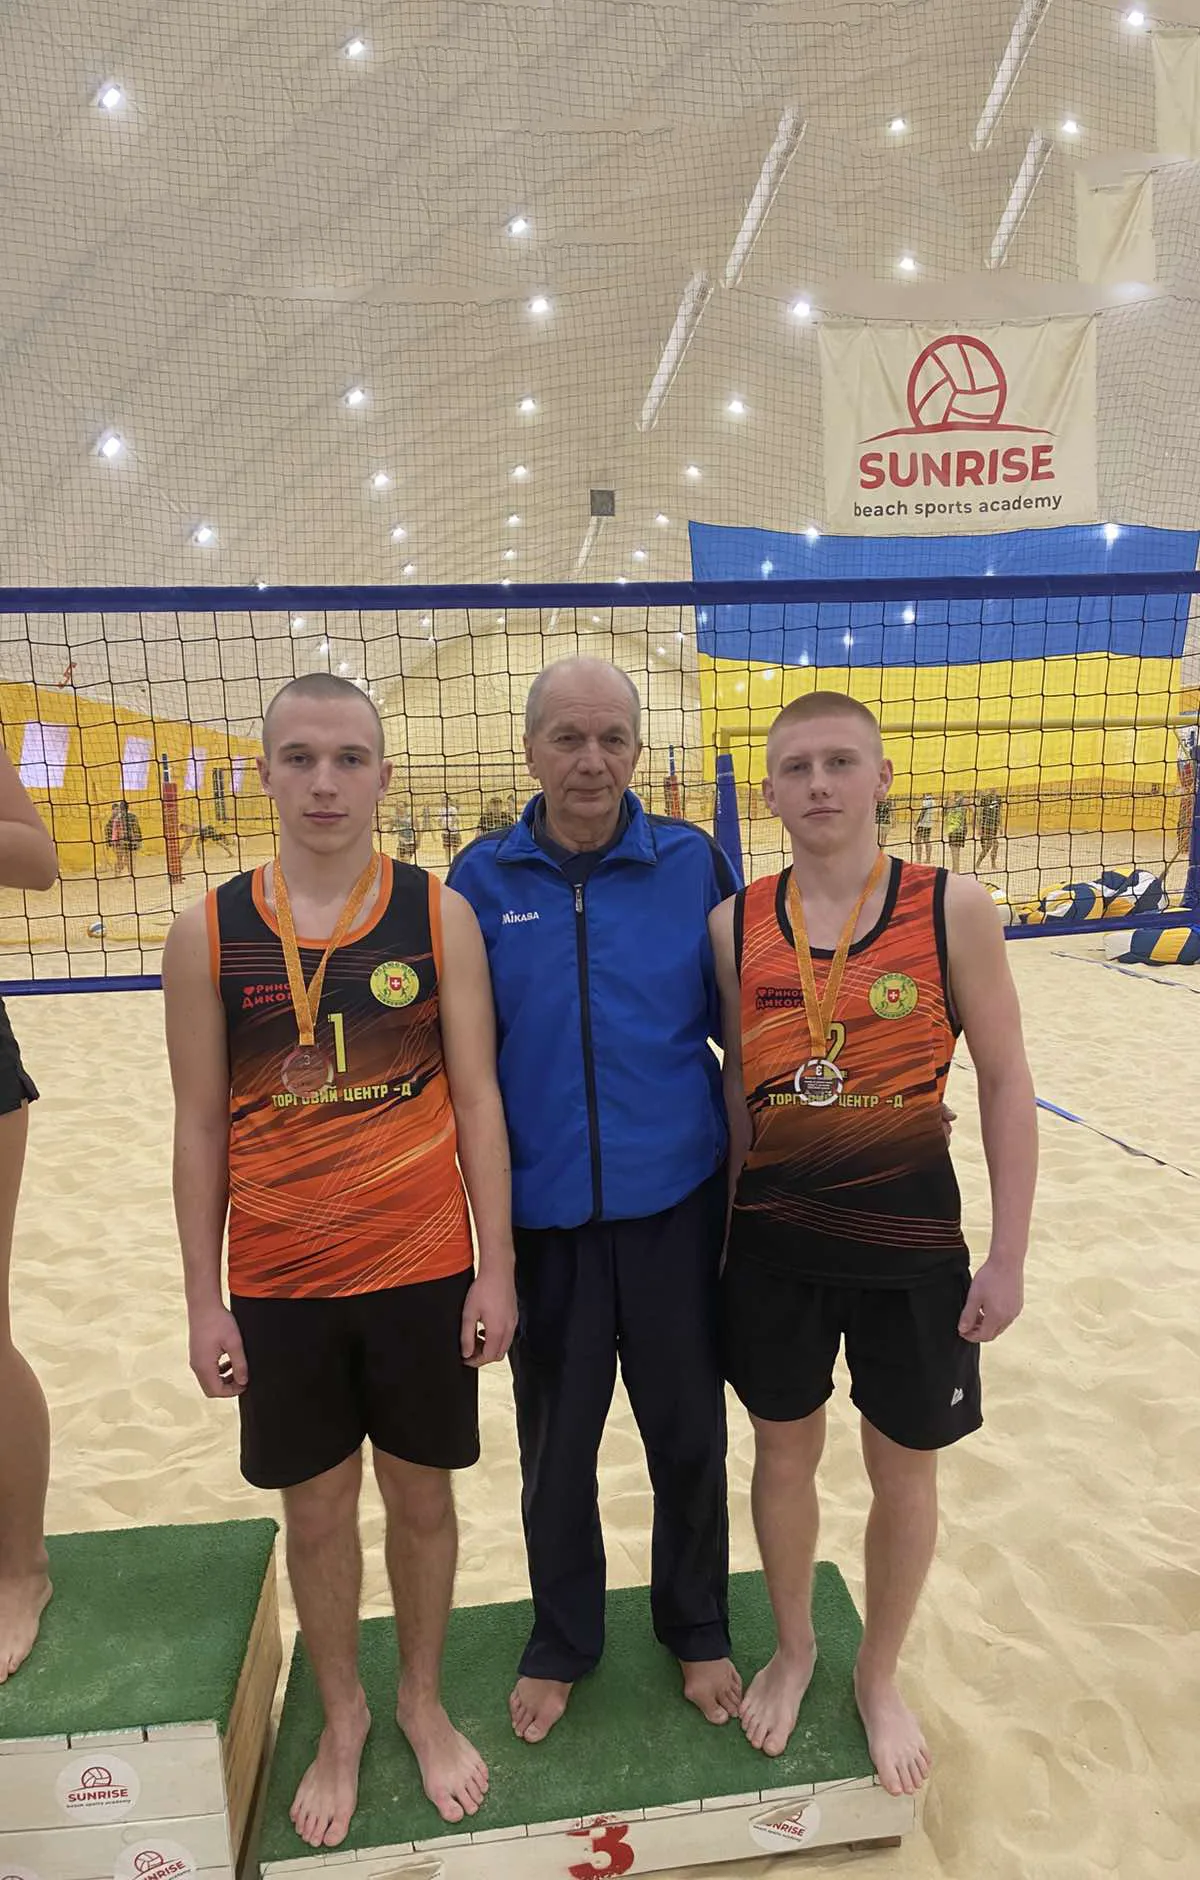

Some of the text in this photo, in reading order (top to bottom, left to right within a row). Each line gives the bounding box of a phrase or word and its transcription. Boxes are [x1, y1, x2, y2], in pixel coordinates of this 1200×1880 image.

[859, 445, 1055, 489] SUNRISE
[854, 495, 1062, 517] beach sports academy
[328, 1013, 346, 1073] 1
[825, 1021, 848, 1078] 2
[344, 1085, 388, 1102] ЦЕНТР
[839, 1094, 879, 1107] ЦЕНТР
[68, 1788, 129, 1802] SUNRISE
[566, 1815, 635, 1880] 3
